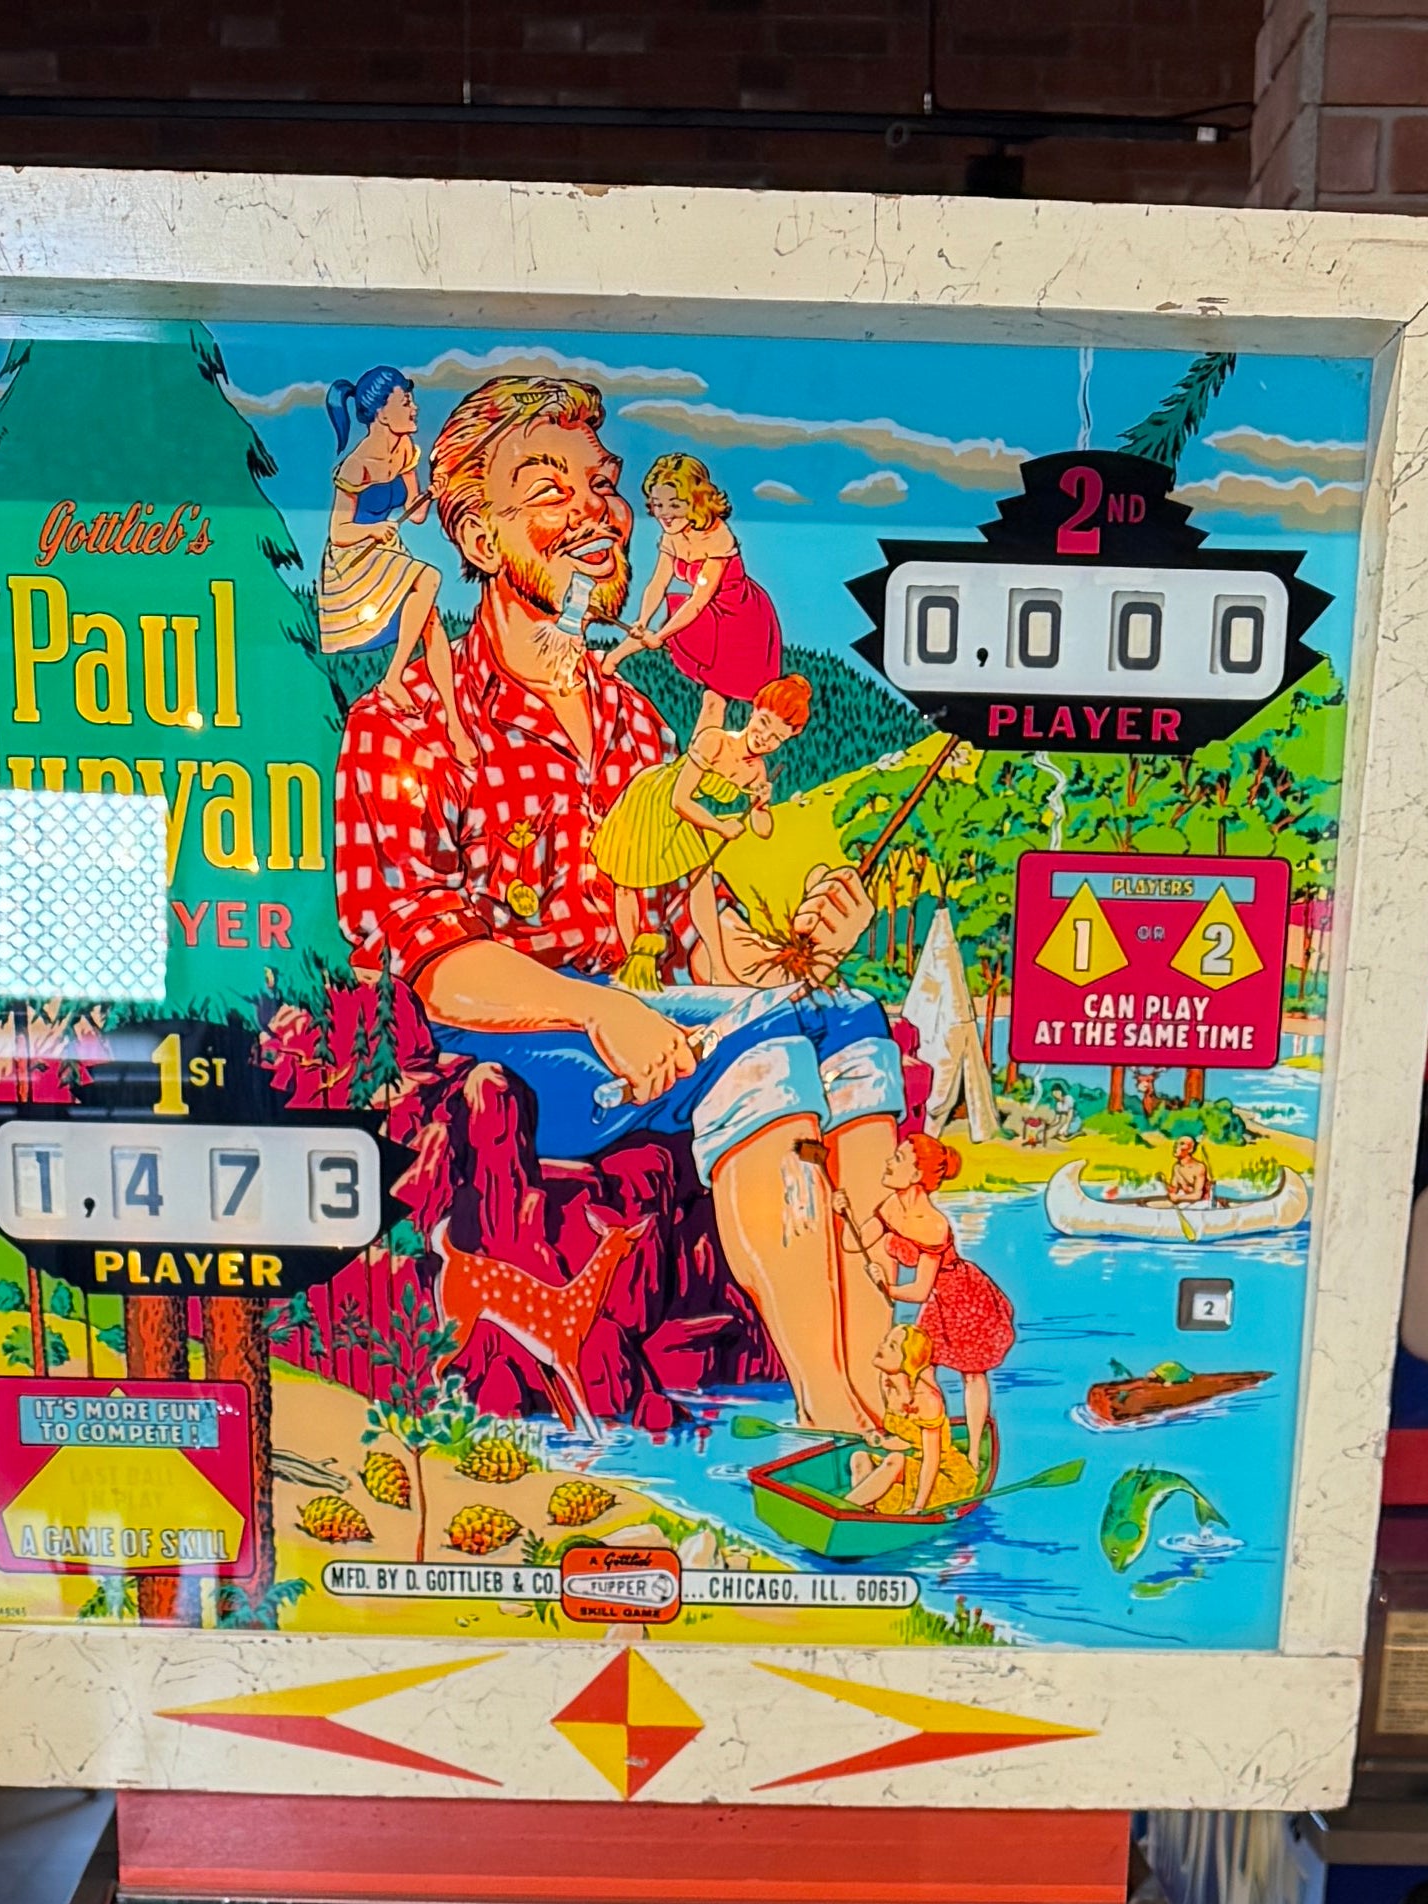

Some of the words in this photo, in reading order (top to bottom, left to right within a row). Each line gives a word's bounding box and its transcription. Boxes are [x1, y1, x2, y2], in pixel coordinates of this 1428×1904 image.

[1057, 466, 1146, 554] 2ND
[36, 501, 214, 567] Gottlieb's
[7, 575, 242, 729] Paul
[987, 705, 1182, 741] PLAYER
[1112, 878, 1194, 897] PLAYERS
[1073, 918, 1092, 972] 1
[1137, 926, 1165, 940] OR
[1200, 922, 1235, 976] 2
[1084, 993, 1134, 1020] CAN
[1144, 995, 1210, 1021] PLAY
[1034, 1021, 1065, 1045] AT
[1072, 1022, 1117, 1046] THE
[1123, 1023, 1189, 1048] SAME
[1196, 1025, 1254, 1050] TIME
[151, 1034, 228, 1115] 1ST
[94, 1250, 283, 1287] PLAYER
[1203, 1300, 1215, 1316] 2
[35, 1400, 77, 1419] IT'S
[85, 1402, 149, 1421] MORE
[159, 1403, 201, 1422] FUN
[40, 1422, 69, 1440] TO
[77, 1423, 183, 1443] COMPETE
[21, 1525, 37, 1556] A
[43, 1525, 115, 1557] GAME
[122, 1529, 152, 1558] OF
[161, 1530, 230, 1560] SKILL
[332, 1569, 372, 1591] MFD.
[377, 1570, 400, 1591] BY
[406, 1571, 421, 1592] D.
[426, 1572, 504, 1594] GOTTLIEB
[513, 1573, 526, 1594] &
[532, 1573, 559, 1595] CO.
[590, 1578, 647, 1597] FLIPPER
[811, 1580, 846, 1601] ILL.
[857, 1580, 910, 1602] 60651
[580, 1606, 618, 1618] SKILL
[623, 1607, 661, 1619] GAME
